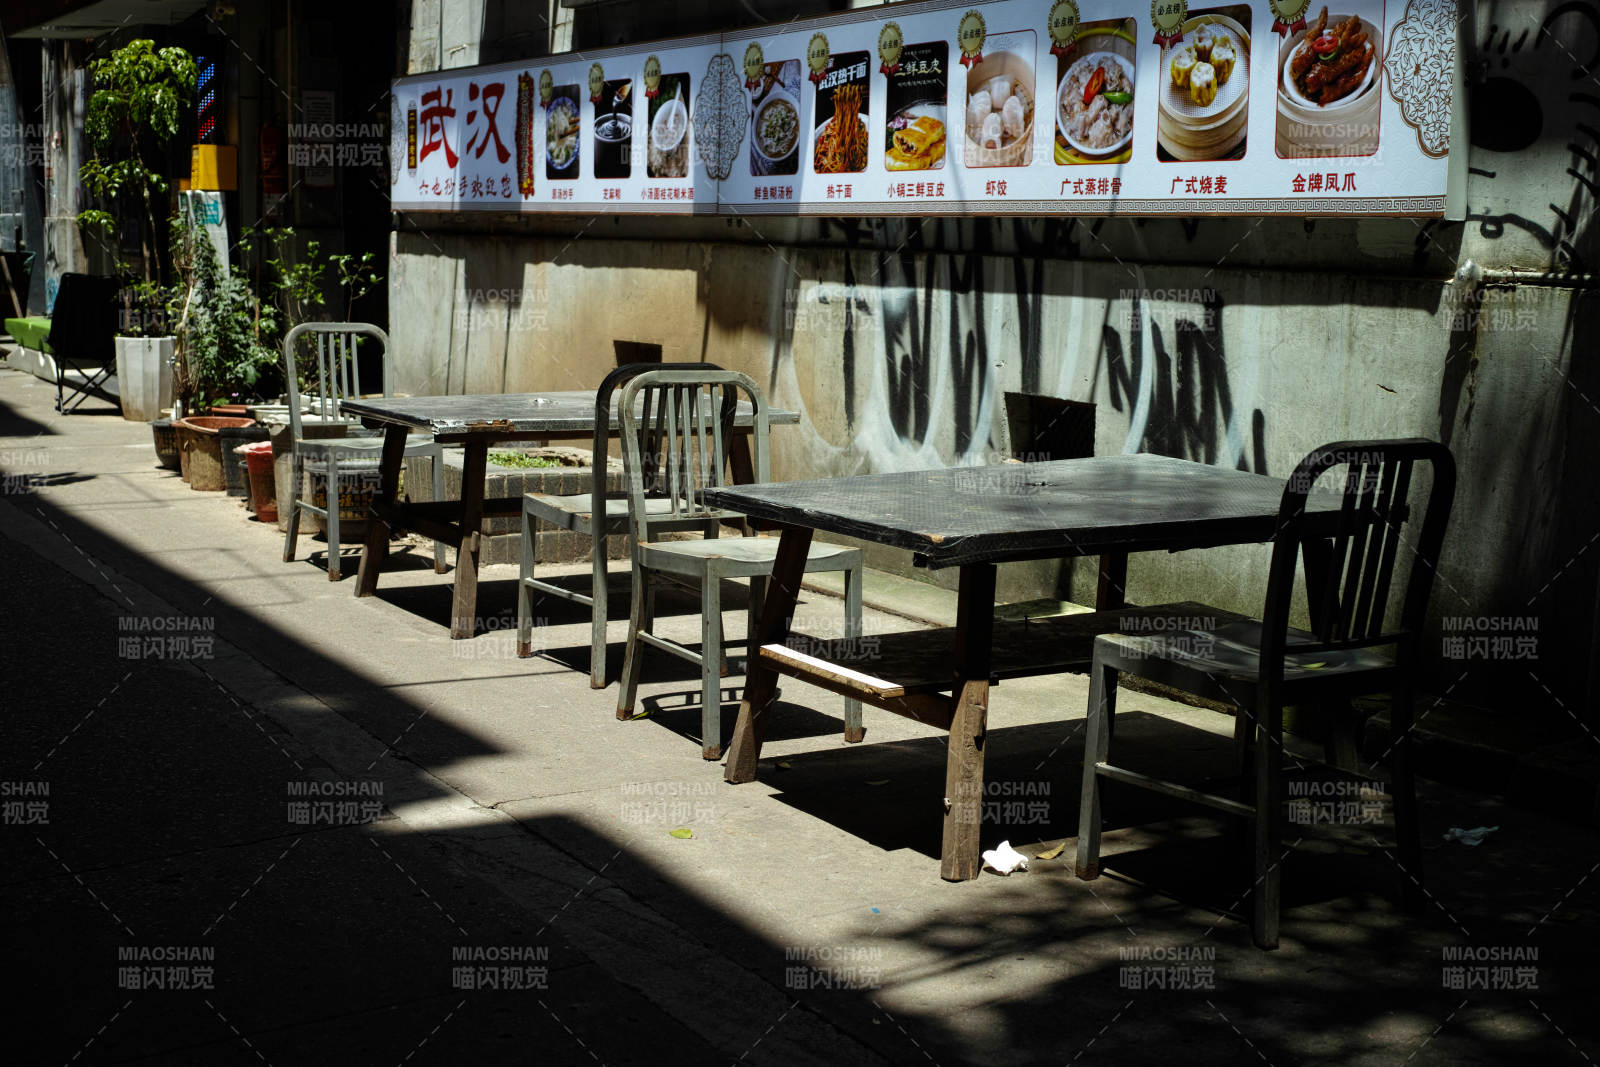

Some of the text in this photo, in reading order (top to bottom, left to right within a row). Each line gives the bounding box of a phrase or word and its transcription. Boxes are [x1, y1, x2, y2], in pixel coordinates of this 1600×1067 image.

[1157, 4, 1182, 16] 必点榜
[1053, 15, 1075, 28] 必点榜
[420, 82, 511, 169] 武汉
[827, 184, 852, 199] 热干面
[887, 182, 945, 198] 小锅三鲜豆皮
[985, 179, 1007, 197] 虾饺
[1060, 177, 1122, 196] 广式蒸排骨
[1170, 175, 1228, 195] 广式烧麦
[1291, 172, 1357, 194] 金牌凤爪
